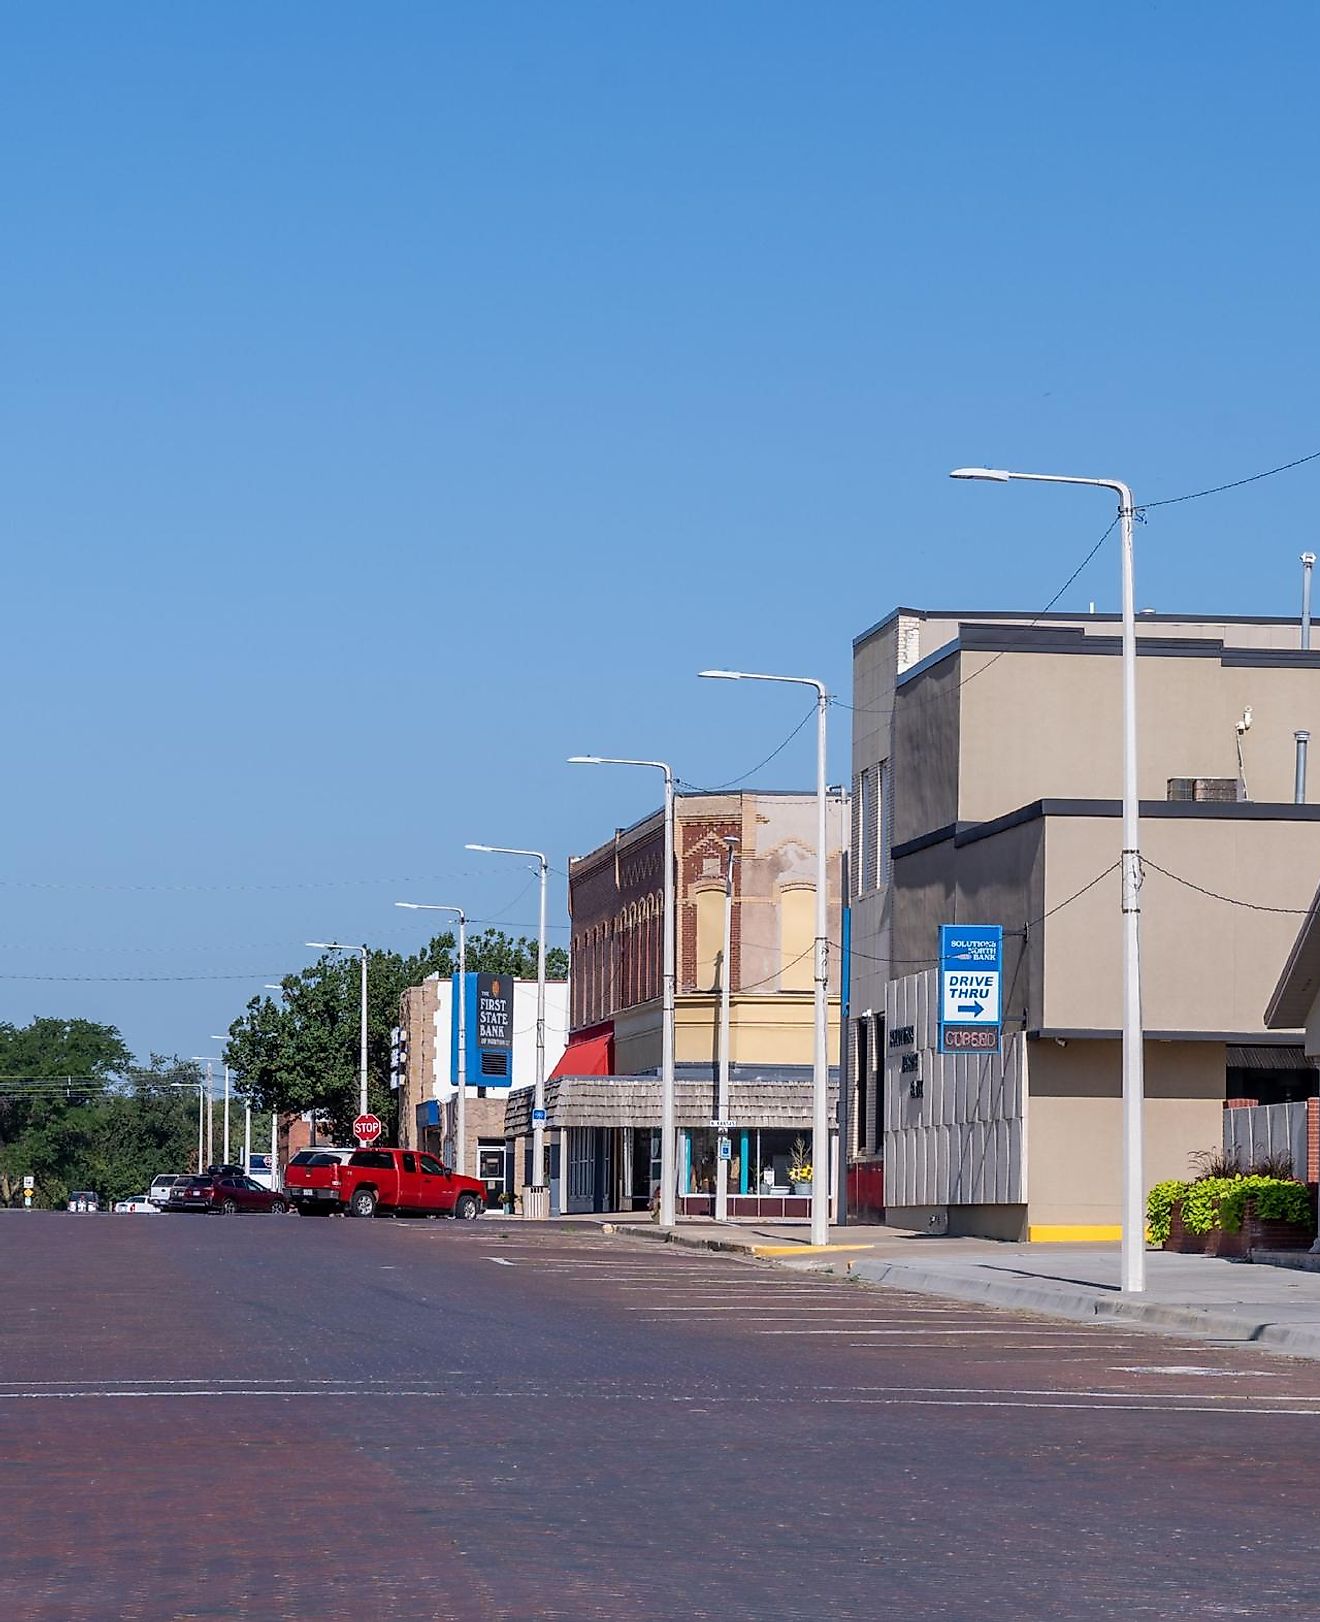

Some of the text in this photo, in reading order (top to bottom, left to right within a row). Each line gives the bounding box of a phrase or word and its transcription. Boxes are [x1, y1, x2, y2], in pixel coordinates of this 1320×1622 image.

[951, 940, 996, 948] SOLUTIONS
[949, 976, 994, 986] DRIVE
[949, 988, 989, 999] THRU
[480, 998, 507, 1011] FIRST
[480, 1011, 508, 1025] STATE
[480, 1024, 505, 1038] BANK
[355, 1122, 379, 1133] STOP
